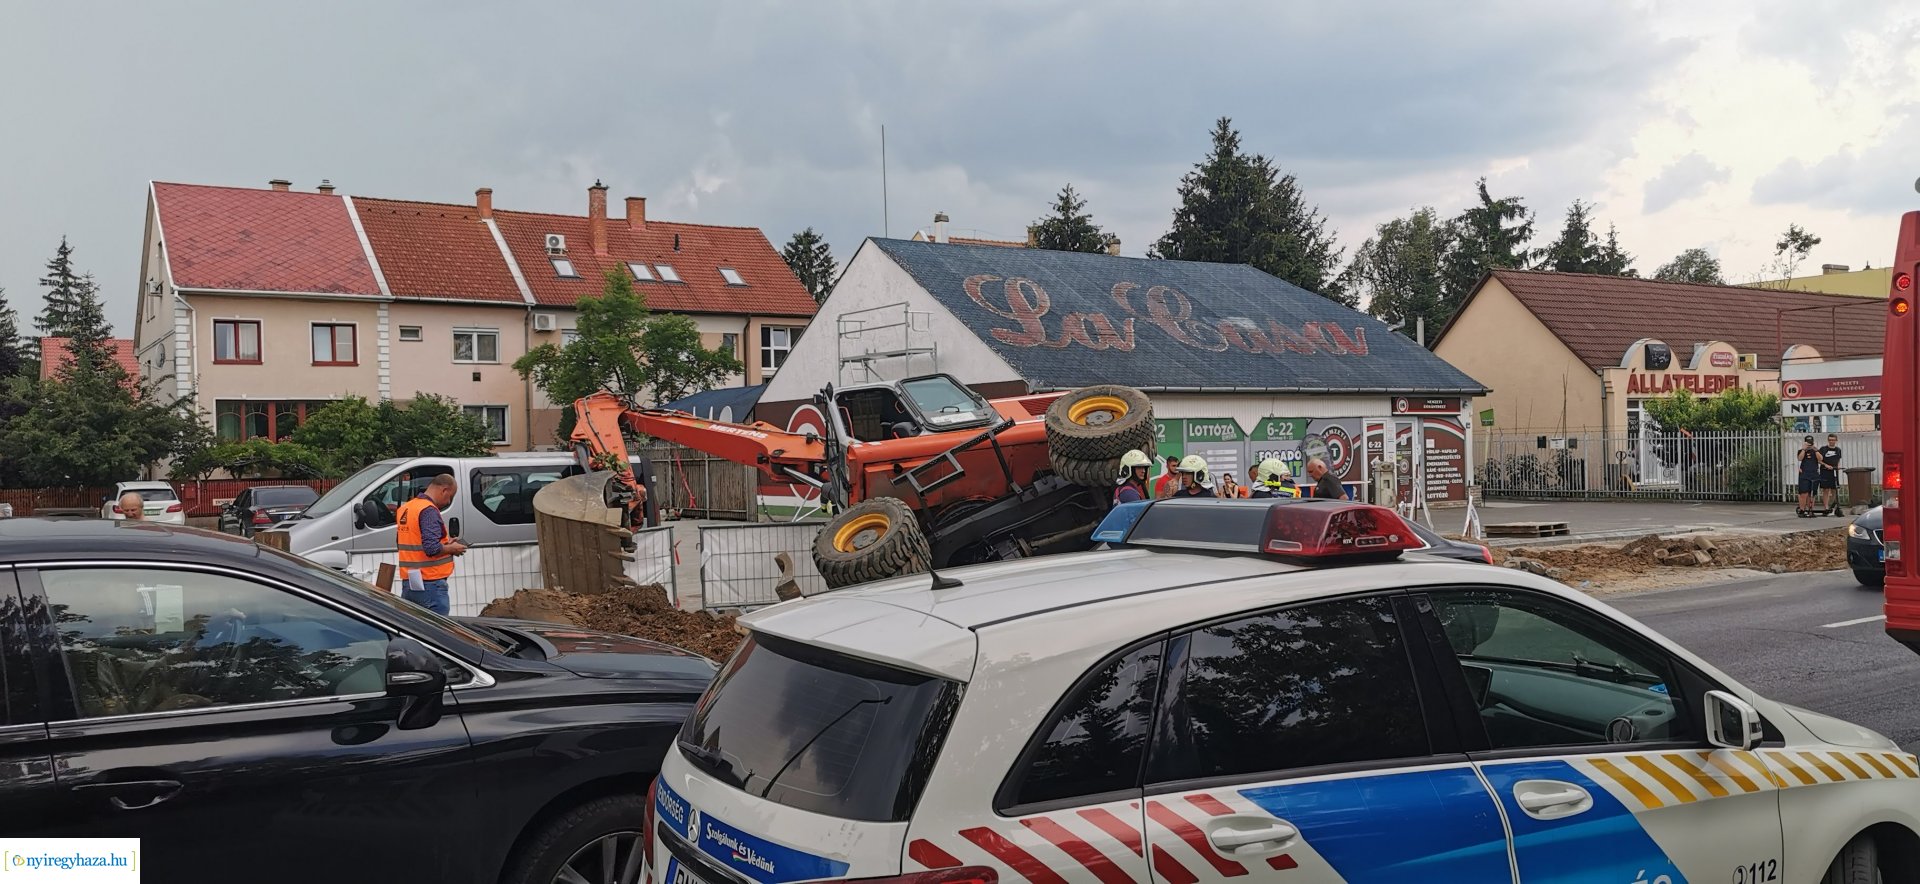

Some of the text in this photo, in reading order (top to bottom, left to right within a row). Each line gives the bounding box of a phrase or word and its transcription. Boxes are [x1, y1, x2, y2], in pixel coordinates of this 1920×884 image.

[963, 273, 1370, 357] La Casa
[1790, 401, 1849, 414] NYITVA:
[708, 424, 769, 440] MERTENS
[1189, 423, 1235, 437] LOTTÓZÓ
[1266, 422, 1293, 436] 6-22
[1258, 446, 1302, 461] FOGADÓ
[706, 822, 747, 856] Szolgálunk és
[1749, 858, 1778, 884] 112
